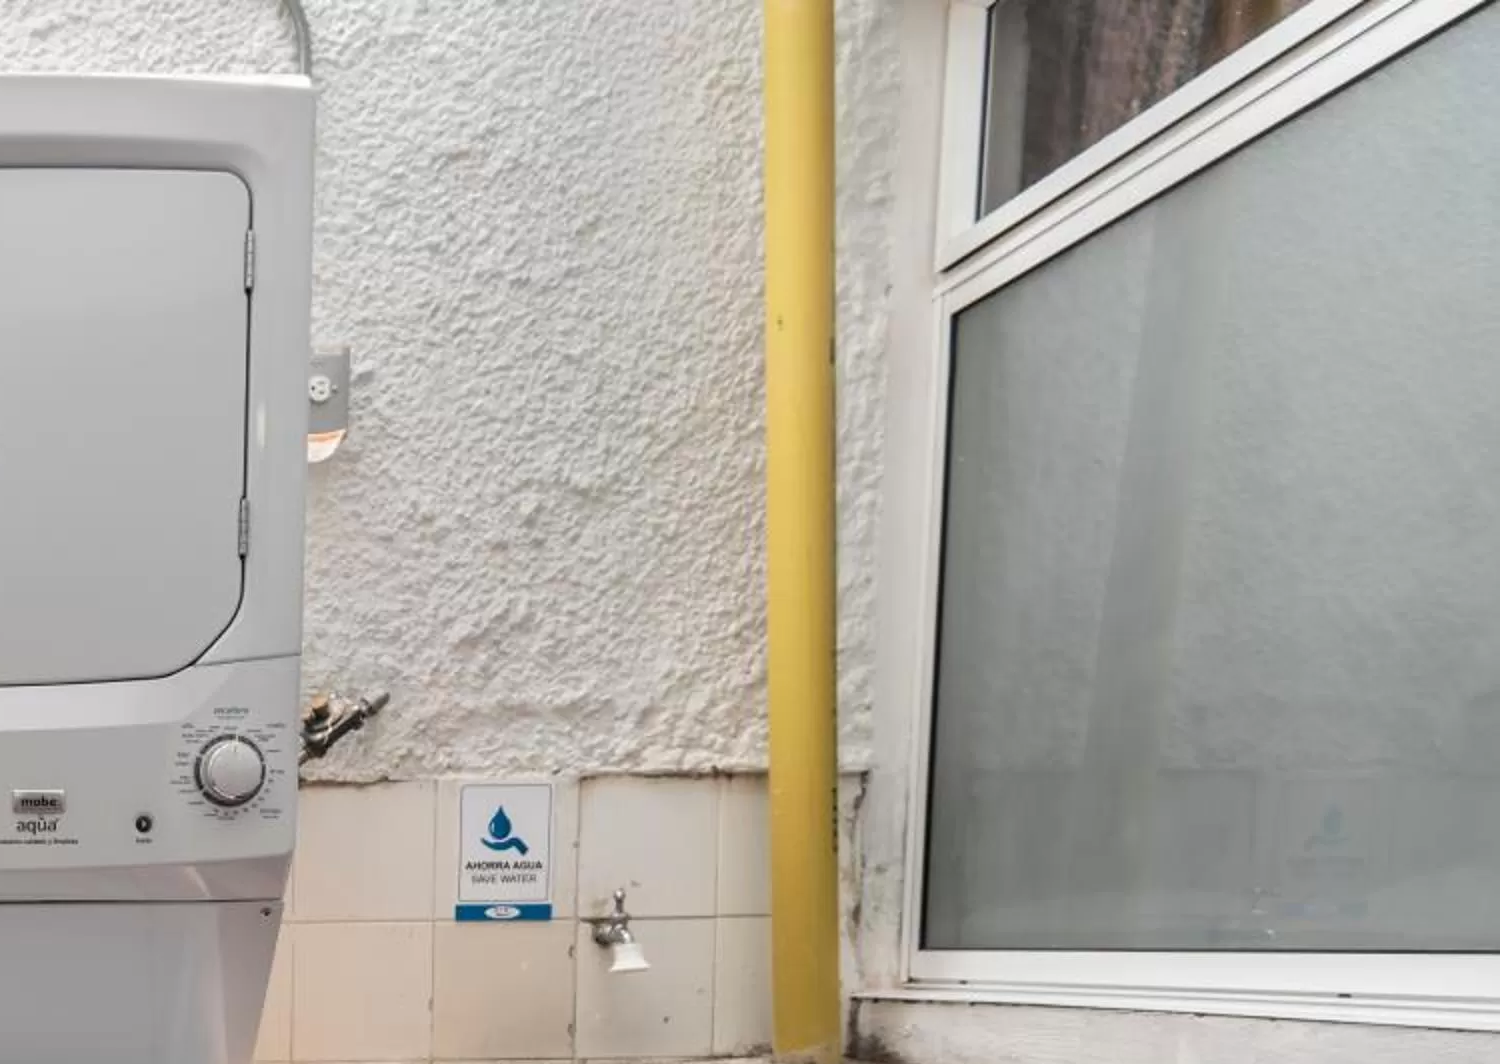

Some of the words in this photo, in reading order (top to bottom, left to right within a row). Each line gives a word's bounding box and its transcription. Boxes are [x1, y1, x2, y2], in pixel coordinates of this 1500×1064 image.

[465, 860, 511, 871] AHORRA
[512, 860, 543, 870] AGUA
[500, 873, 537, 883] WATER
